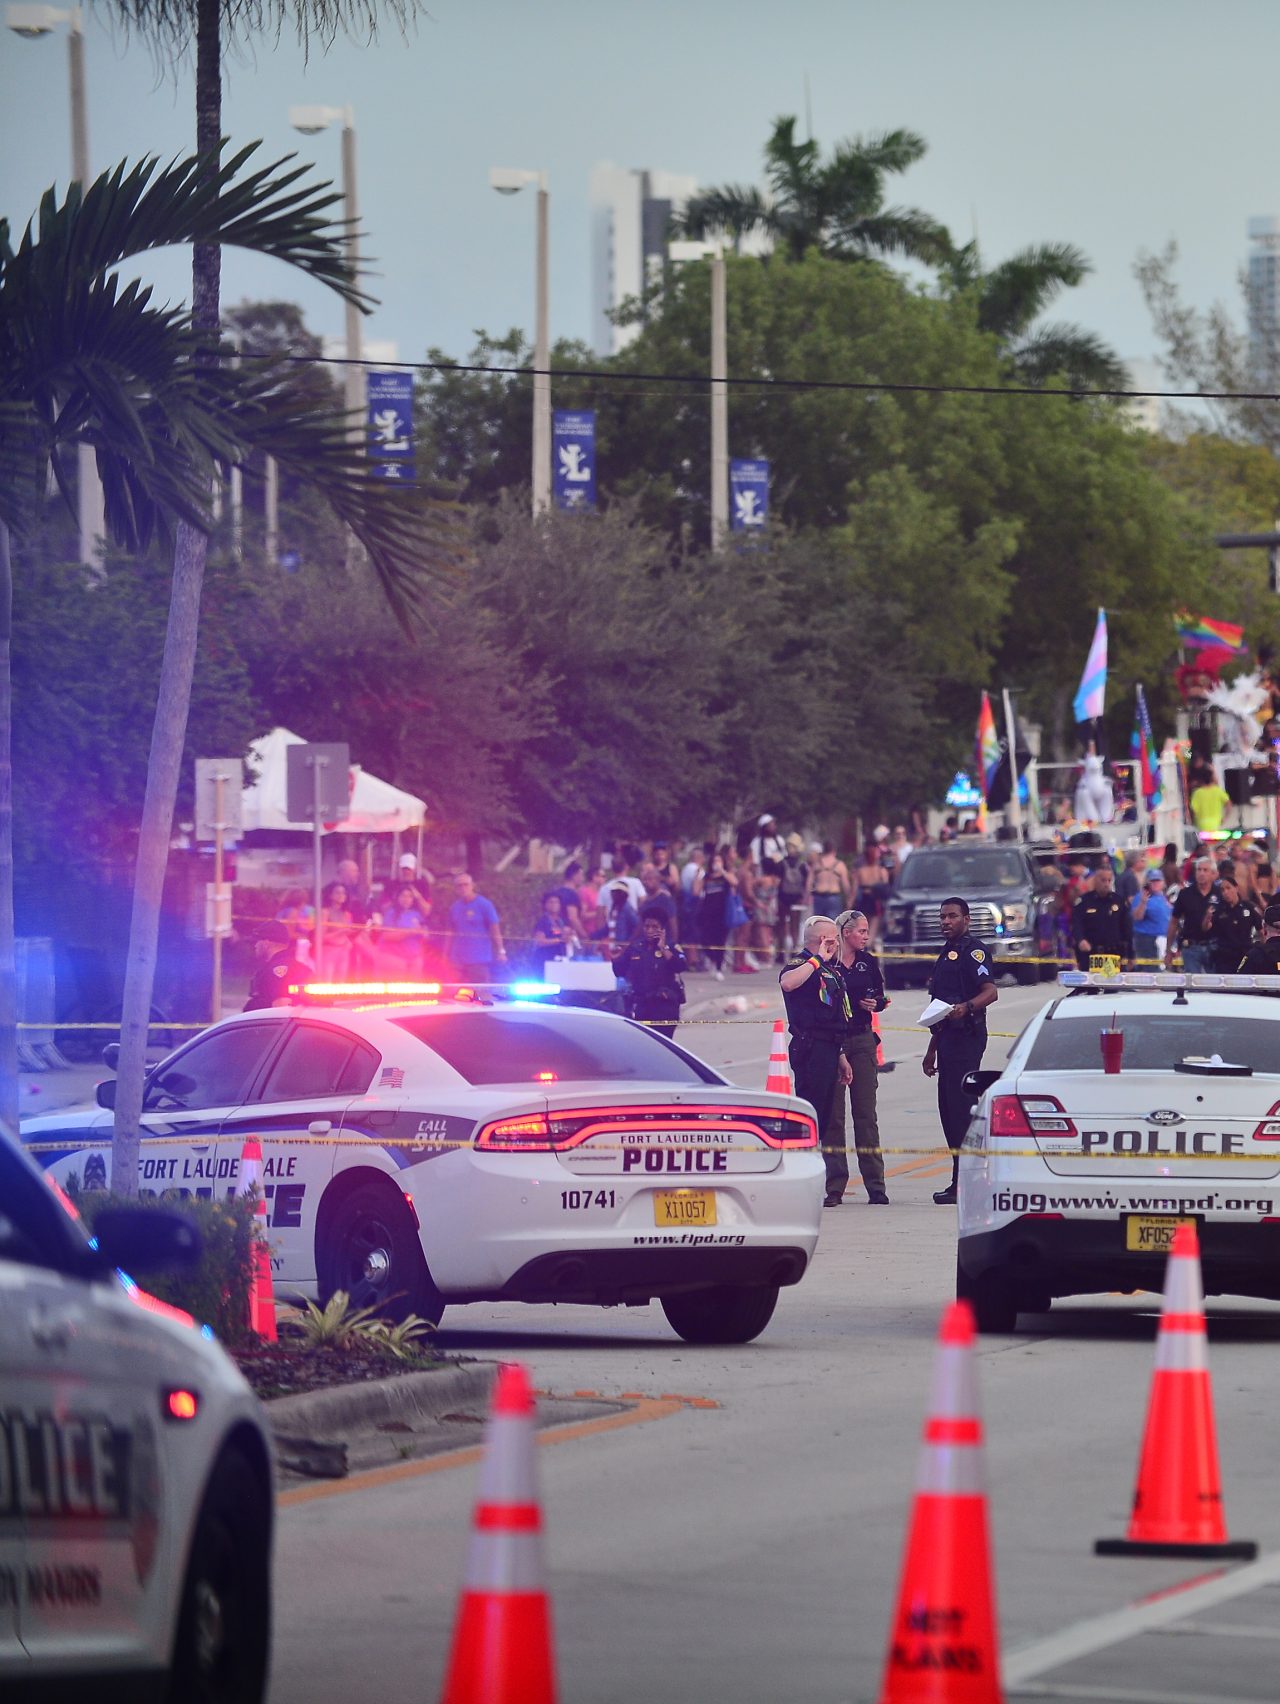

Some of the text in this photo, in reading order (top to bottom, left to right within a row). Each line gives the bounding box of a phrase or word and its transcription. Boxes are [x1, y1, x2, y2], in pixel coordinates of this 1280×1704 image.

[1154, 1110, 1175, 1121] Ford
[418, 1119, 448, 1132] CALL
[411, 1132, 447, 1152] 911
[620, 1134, 734, 1145] FORT LAUDERDALE
[1081, 1130, 1245, 1155] POLICE
[137, 1156, 298, 1179] FORT LAUDEALE
[622, 1146, 728, 1173] POLICE
[561, 1190, 616, 1210] 10741
[665, 1200, 706, 1219] XI1057
[992, 1192, 1274, 1215] 1609 www.wmpd.org
[633, 1233, 746, 1246] www.flpd.org
[1138, 1226, 1177, 1244] XF052
